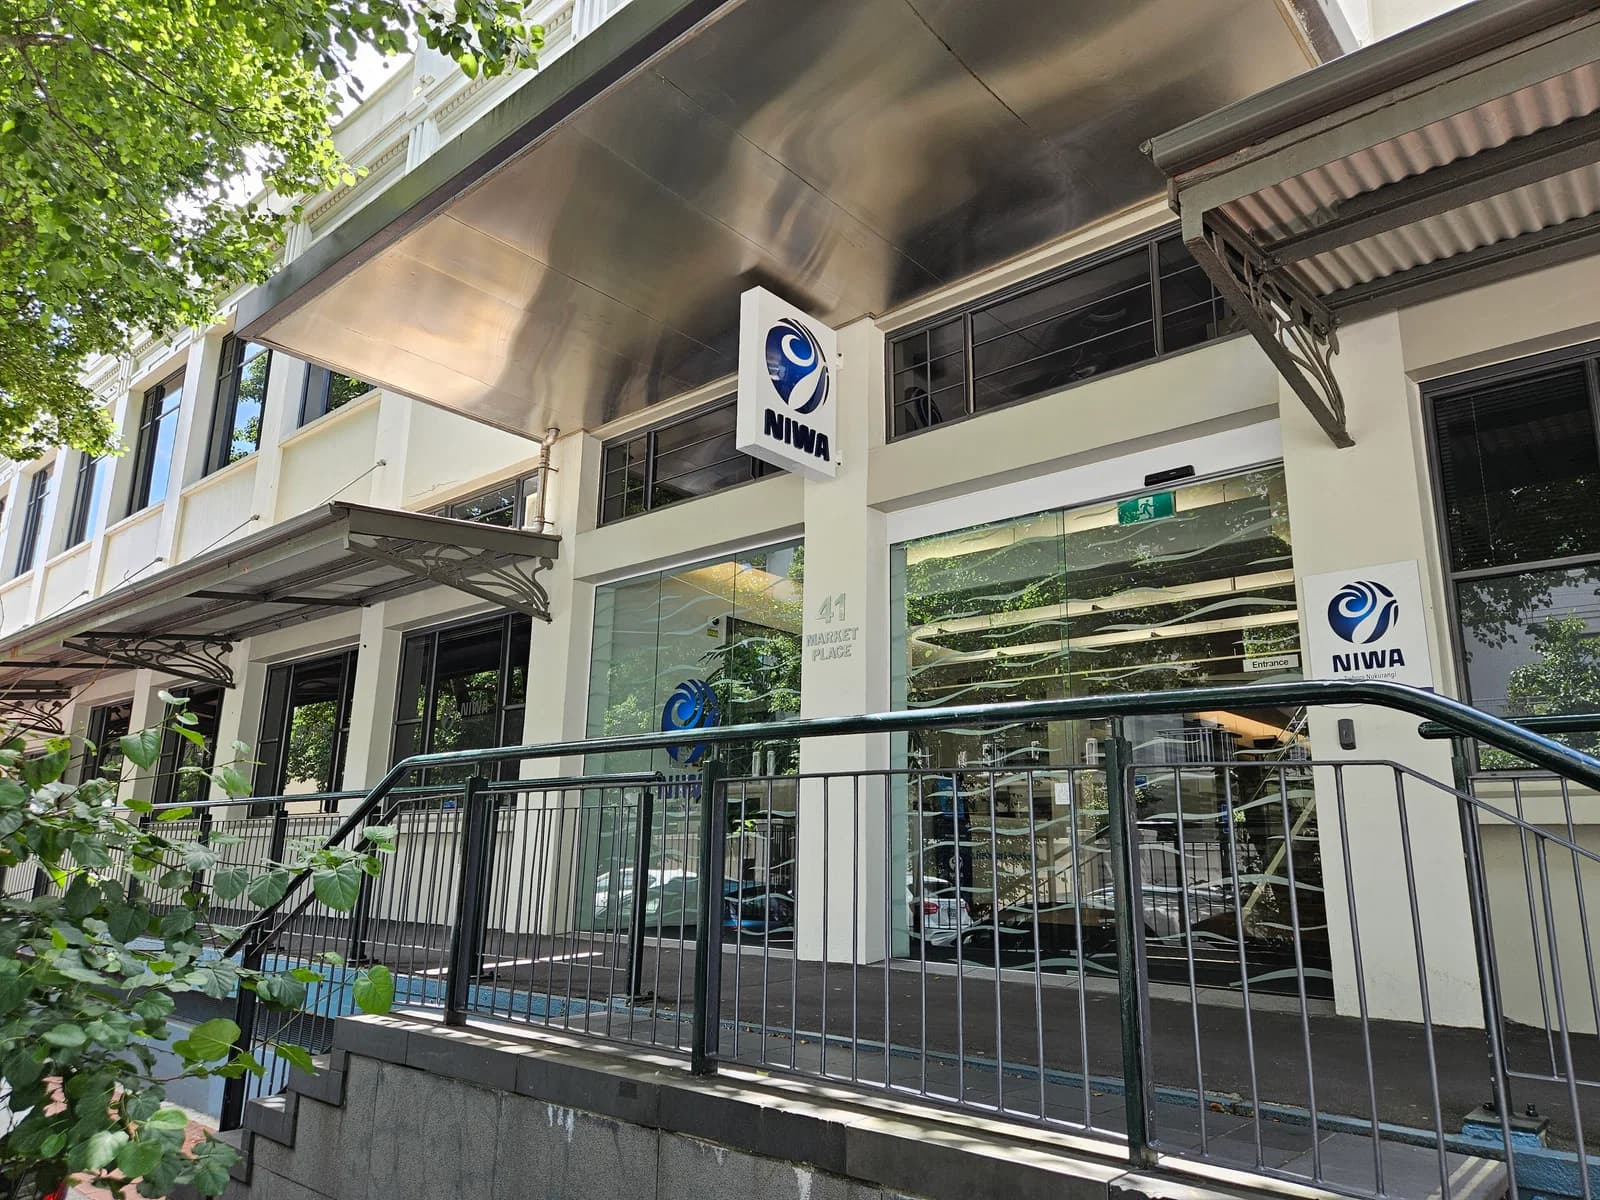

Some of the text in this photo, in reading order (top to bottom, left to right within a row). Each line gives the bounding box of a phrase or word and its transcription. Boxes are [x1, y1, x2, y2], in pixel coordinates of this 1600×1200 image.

[764, 408, 830, 461] NIWA
[816, 592, 846, 624] 41
[806, 627, 859, 646] MARKET
[812, 645, 852, 662] PLACE
[1332, 648, 1405, 672] NIWA
[1252, 658, 1289, 669] Entrance
[461, 700, 488, 716] NIWA
